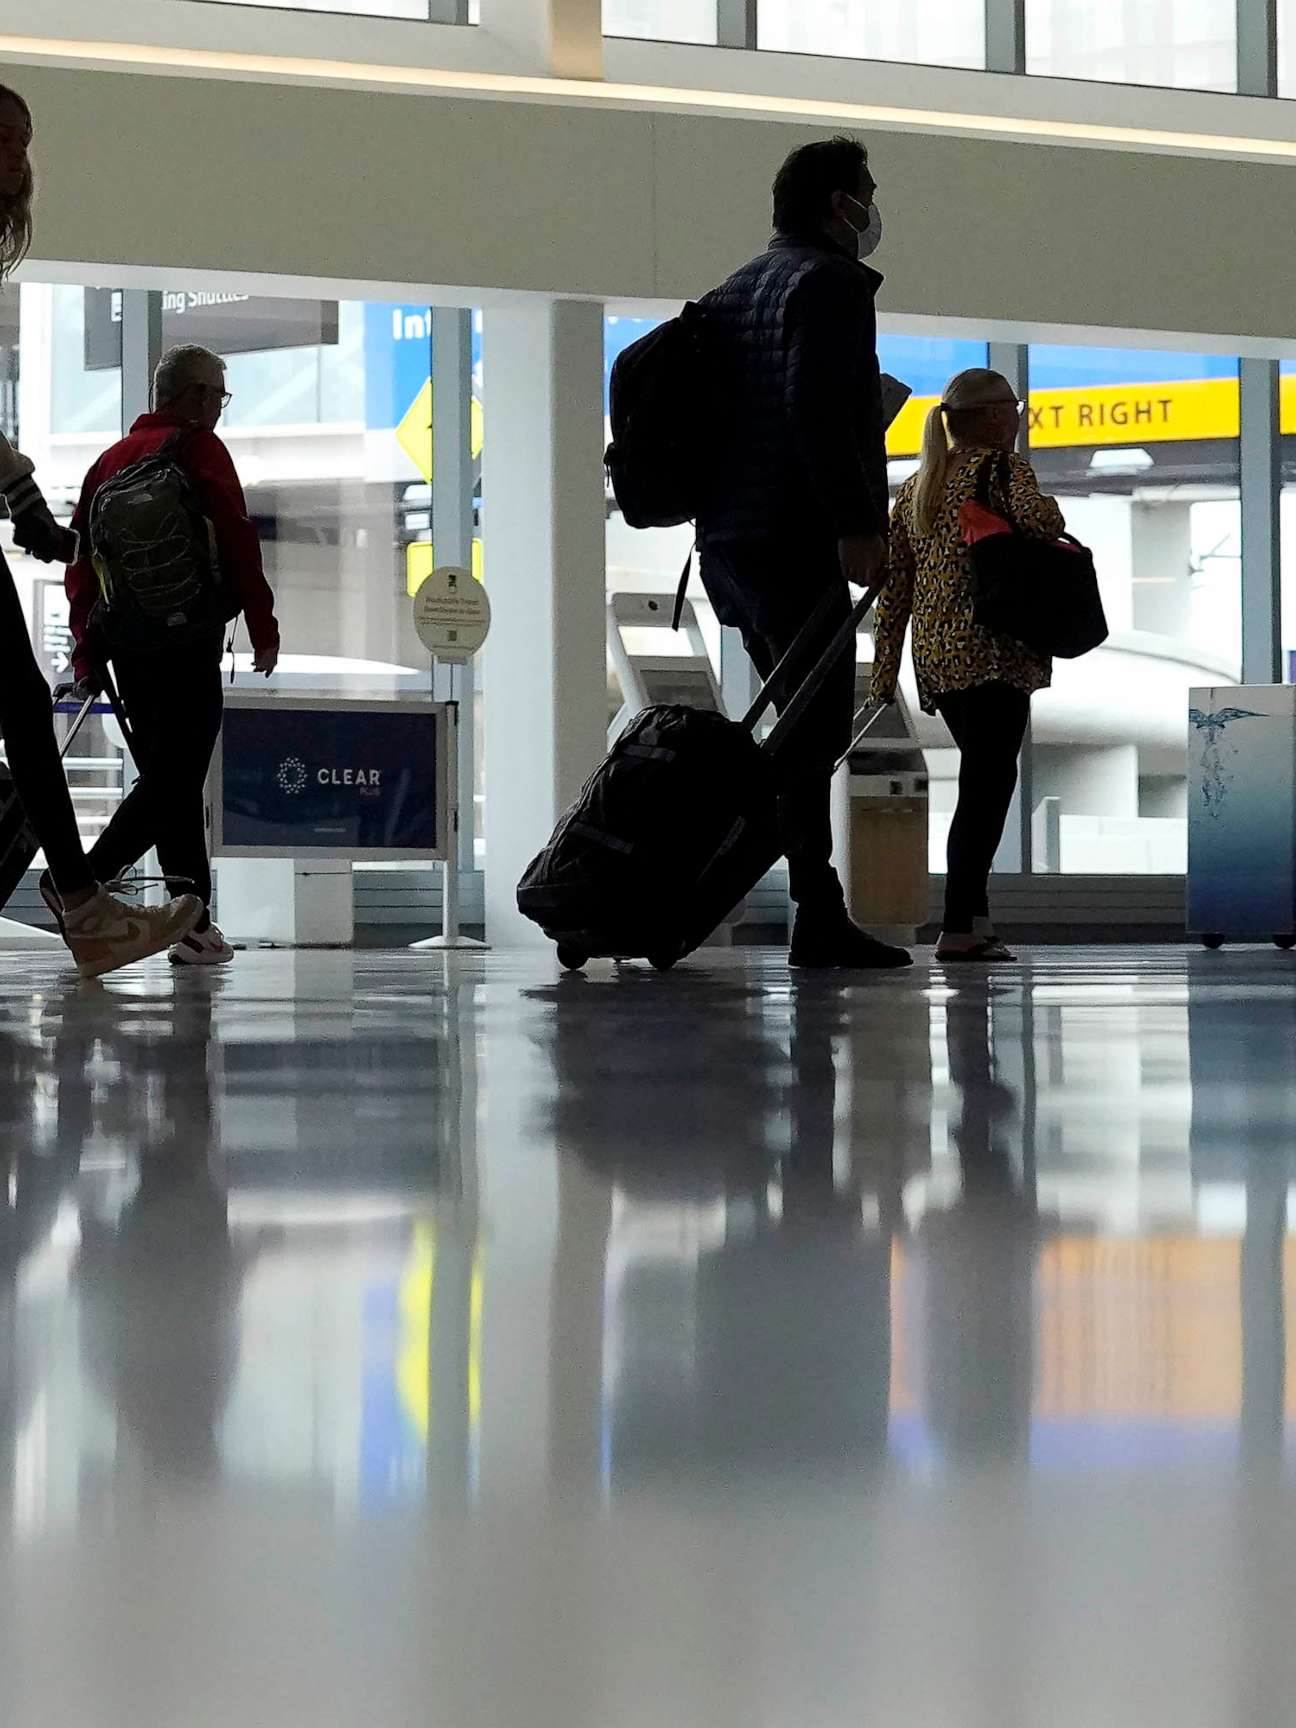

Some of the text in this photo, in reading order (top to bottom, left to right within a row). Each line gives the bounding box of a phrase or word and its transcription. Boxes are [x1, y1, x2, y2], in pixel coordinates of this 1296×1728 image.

[161, 290, 185, 314] ing
[1029, 399, 1173, 430] XT RIGHT
[317, 768, 380, 785] CLEAR
